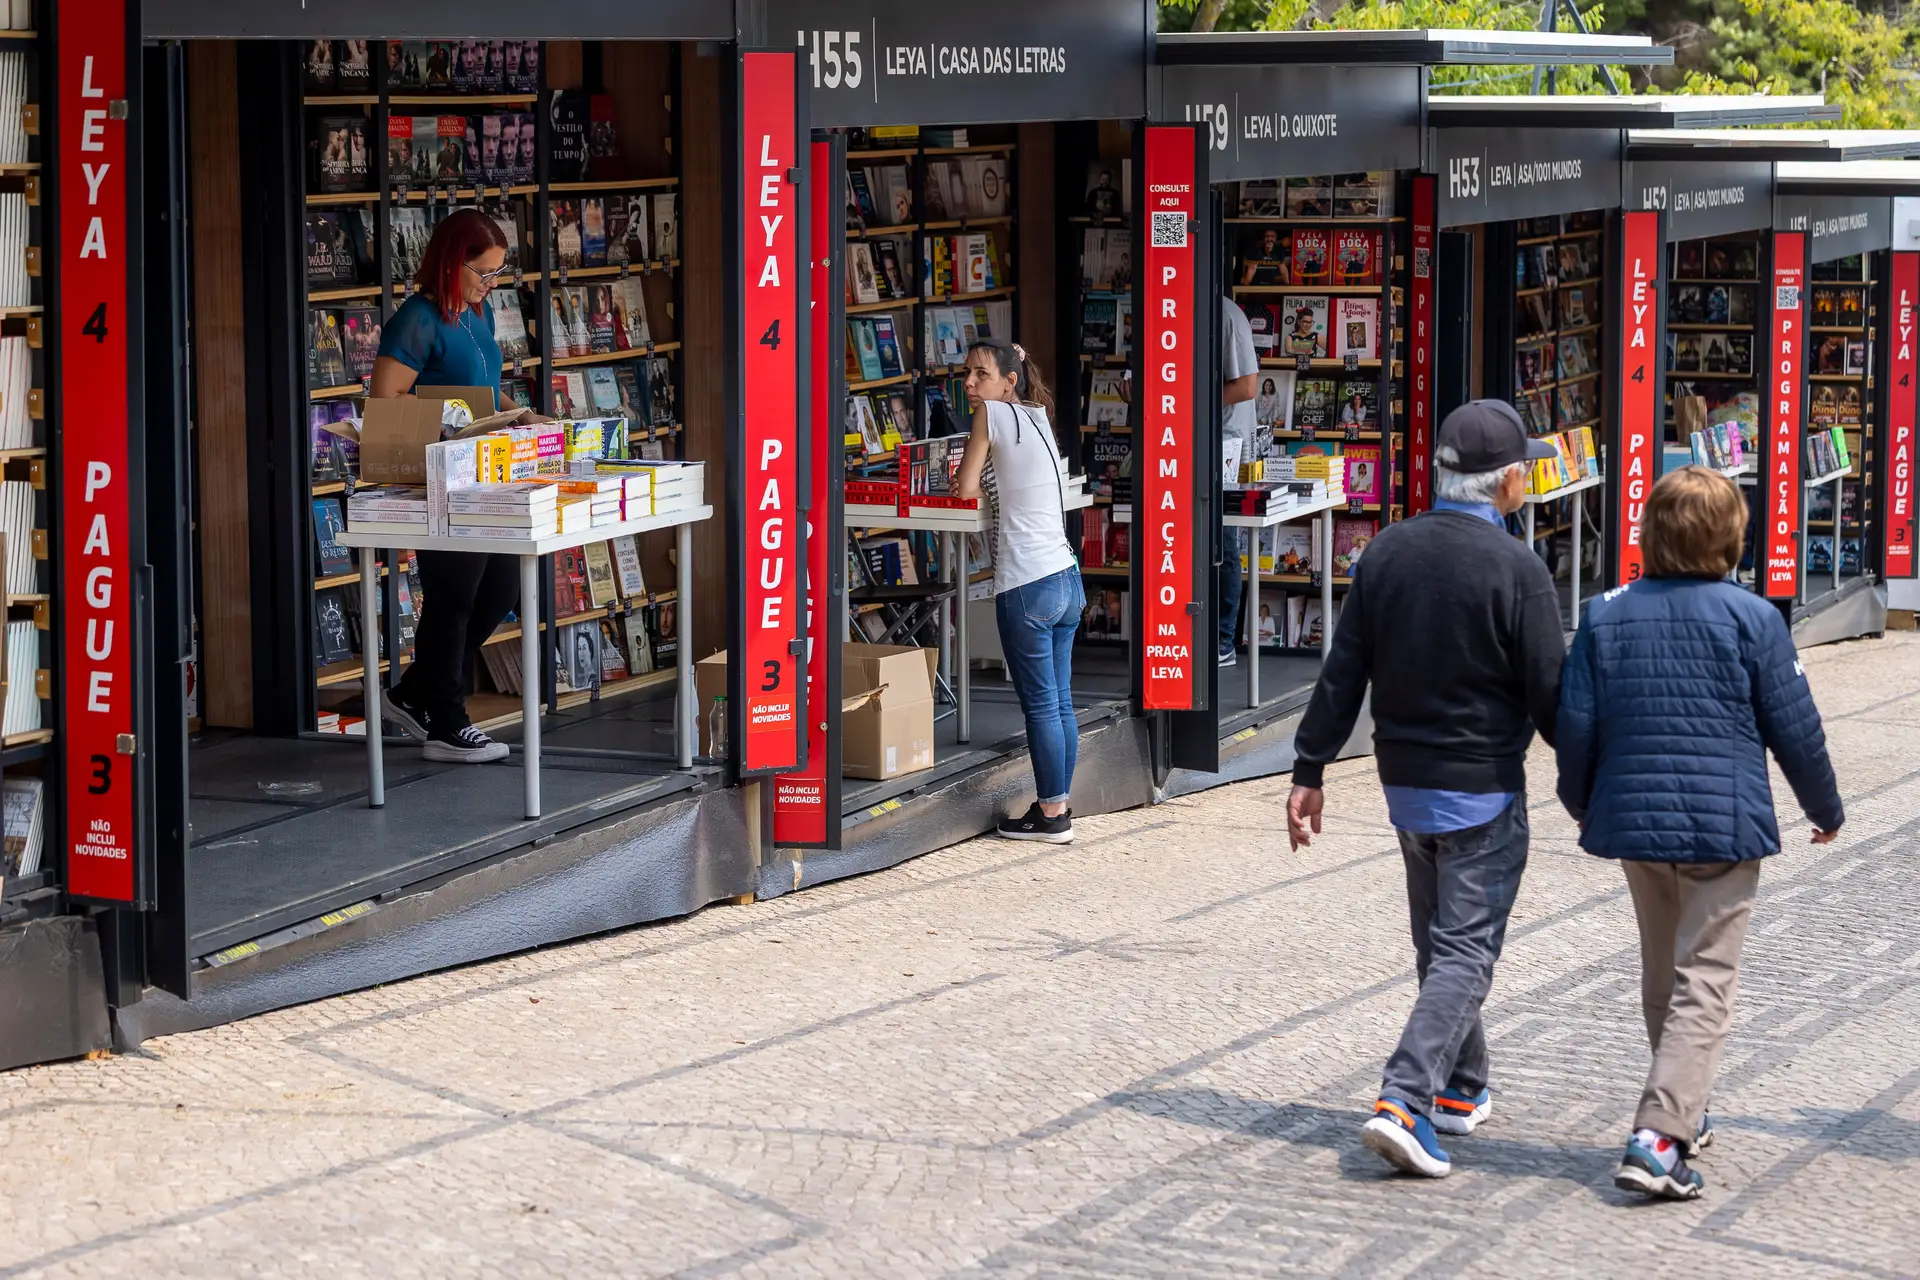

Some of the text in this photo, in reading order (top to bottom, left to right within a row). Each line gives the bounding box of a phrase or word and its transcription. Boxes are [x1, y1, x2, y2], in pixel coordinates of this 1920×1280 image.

[886, 46, 1066, 75] LEYA CASA DAS LETRAS
[557, 123, 583, 132] ESTILO
[1244, 114, 1338, 139] LEYA D. QUIXOTE
[562, 137, 574, 146] DO
[553, 150, 580, 160] TEMPO
[1449, 157, 1480, 199] H53
[1490, 159, 1582, 187] LEYA ASA/1001 MUNDOS
[1149, 184, 1190, 193] CONSULTE
[1159, 198, 1180, 207] AQUI
[1674, 186, 1745, 212] LEYA ASA/1001 MUNDOS
[1812, 220, 1826, 238] LEYA
[1848, 212, 1868, 230] MUNDOS
[1297, 239, 1327, 249] BOCA
[1339, 239, 1370, 249] BOCA
[308, 255, 332, 266] WARD
[1775, 268, 1801, 276] CONSULTE
[1285, 299, 1326, 309] FILIPA GOMES
[1897, 289, 1912, 360] LEYA
[349, 351, 378, 362] WARD
[1898, 373, 1910, 387] 4
[1345, 387, 1371, 396] CHEF
[758, 134, 784, 692] LEYA 4 PAGUE 3
[79, 55, 114, 795] LEYA 4 PAGUE 3
[1301, 415, 1325, 424] CHEF
[1627, 258, 1648, 581] LEYA 4 PAGUE 3
[1776, 320, 1791, 535] PROGRAMAÇÃO
[538, 437, 557, 445] HARUKI
[1159, 266, 1178, 606] PROGRAMAÇÃO
[515, 442, 533, 450] HARUKI
[1094, 444, 1129, 454] LIVRO
[1894, 426, 1909, 515] PAGUE
[1894, 527, 1905, 542] 3
[320, 540, 336, 549] DEST
[1775, 544, 1788, 554] NA
[1768, 558, 1796, 570] PRAÇA
[1771, 572, 1792, 582] LEYA
[1158, 623, 1177, 636] NA
[1146, 645, 1189, 661] PRAÇA
[1151, 667, 1184, 679] LEYA
[752, 703, 790, 714] NÃO INCLUI
[752, 714, 792, 724] NOVIDADES
[778, 785, 820, 795] NÃO INCLUI
[778, 795, 821, 805] NOVIDADES
[90, 819, 111, 833] NÃO
[86, 833, 116, 846] INCLUI
[75, 844, 127, 860] NOVIDADES
